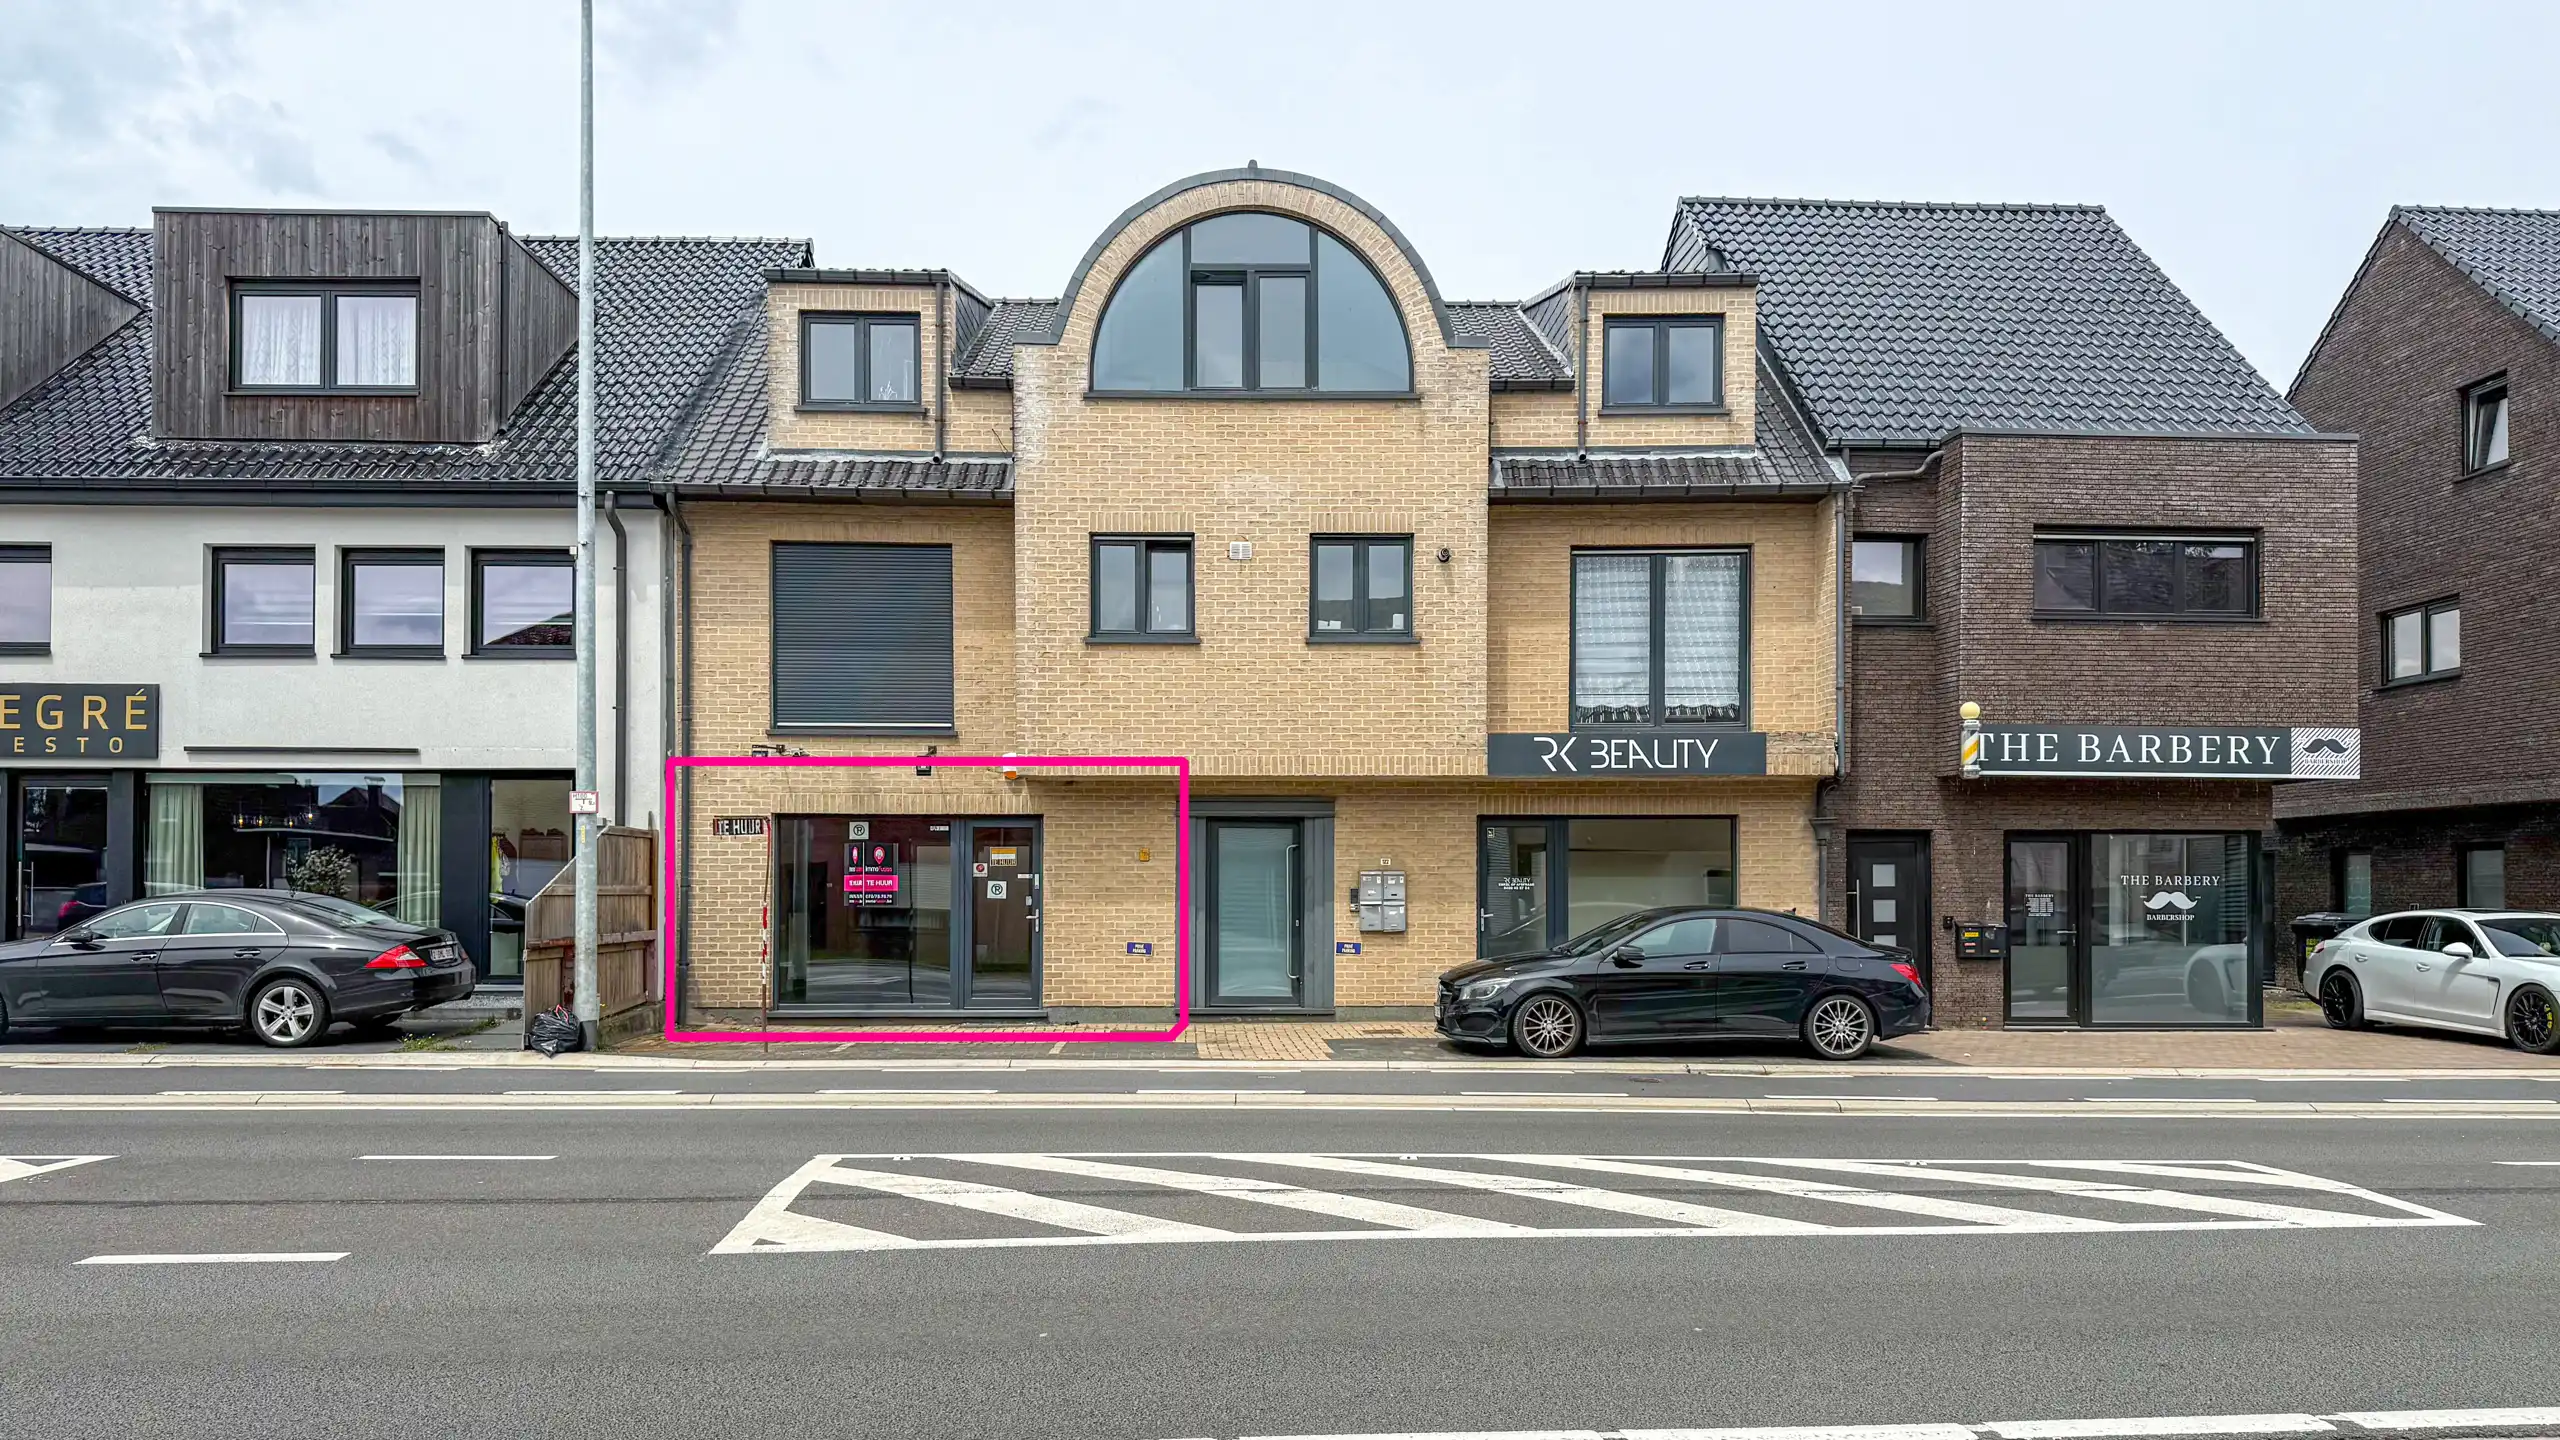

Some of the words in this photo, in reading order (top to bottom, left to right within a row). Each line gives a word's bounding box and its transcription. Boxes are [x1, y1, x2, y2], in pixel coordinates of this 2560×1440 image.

[0, 688, 148, 730] EGRÉ
[13, 736, 124, 753] ESTO
[1533, 736, 1578, 772] RK
[1590, 738, 1719, 769] BEAUTY
[1976, 733, 2059, 763] THE
[2077, 734, 2281, 765] BARBERY
[718, 820, 730, 835] TE
[733, 819, 761, 834] HUUR
[2120, 874, 2150, 886] THE
[2155, 875, 2220, 886] BARBERY
